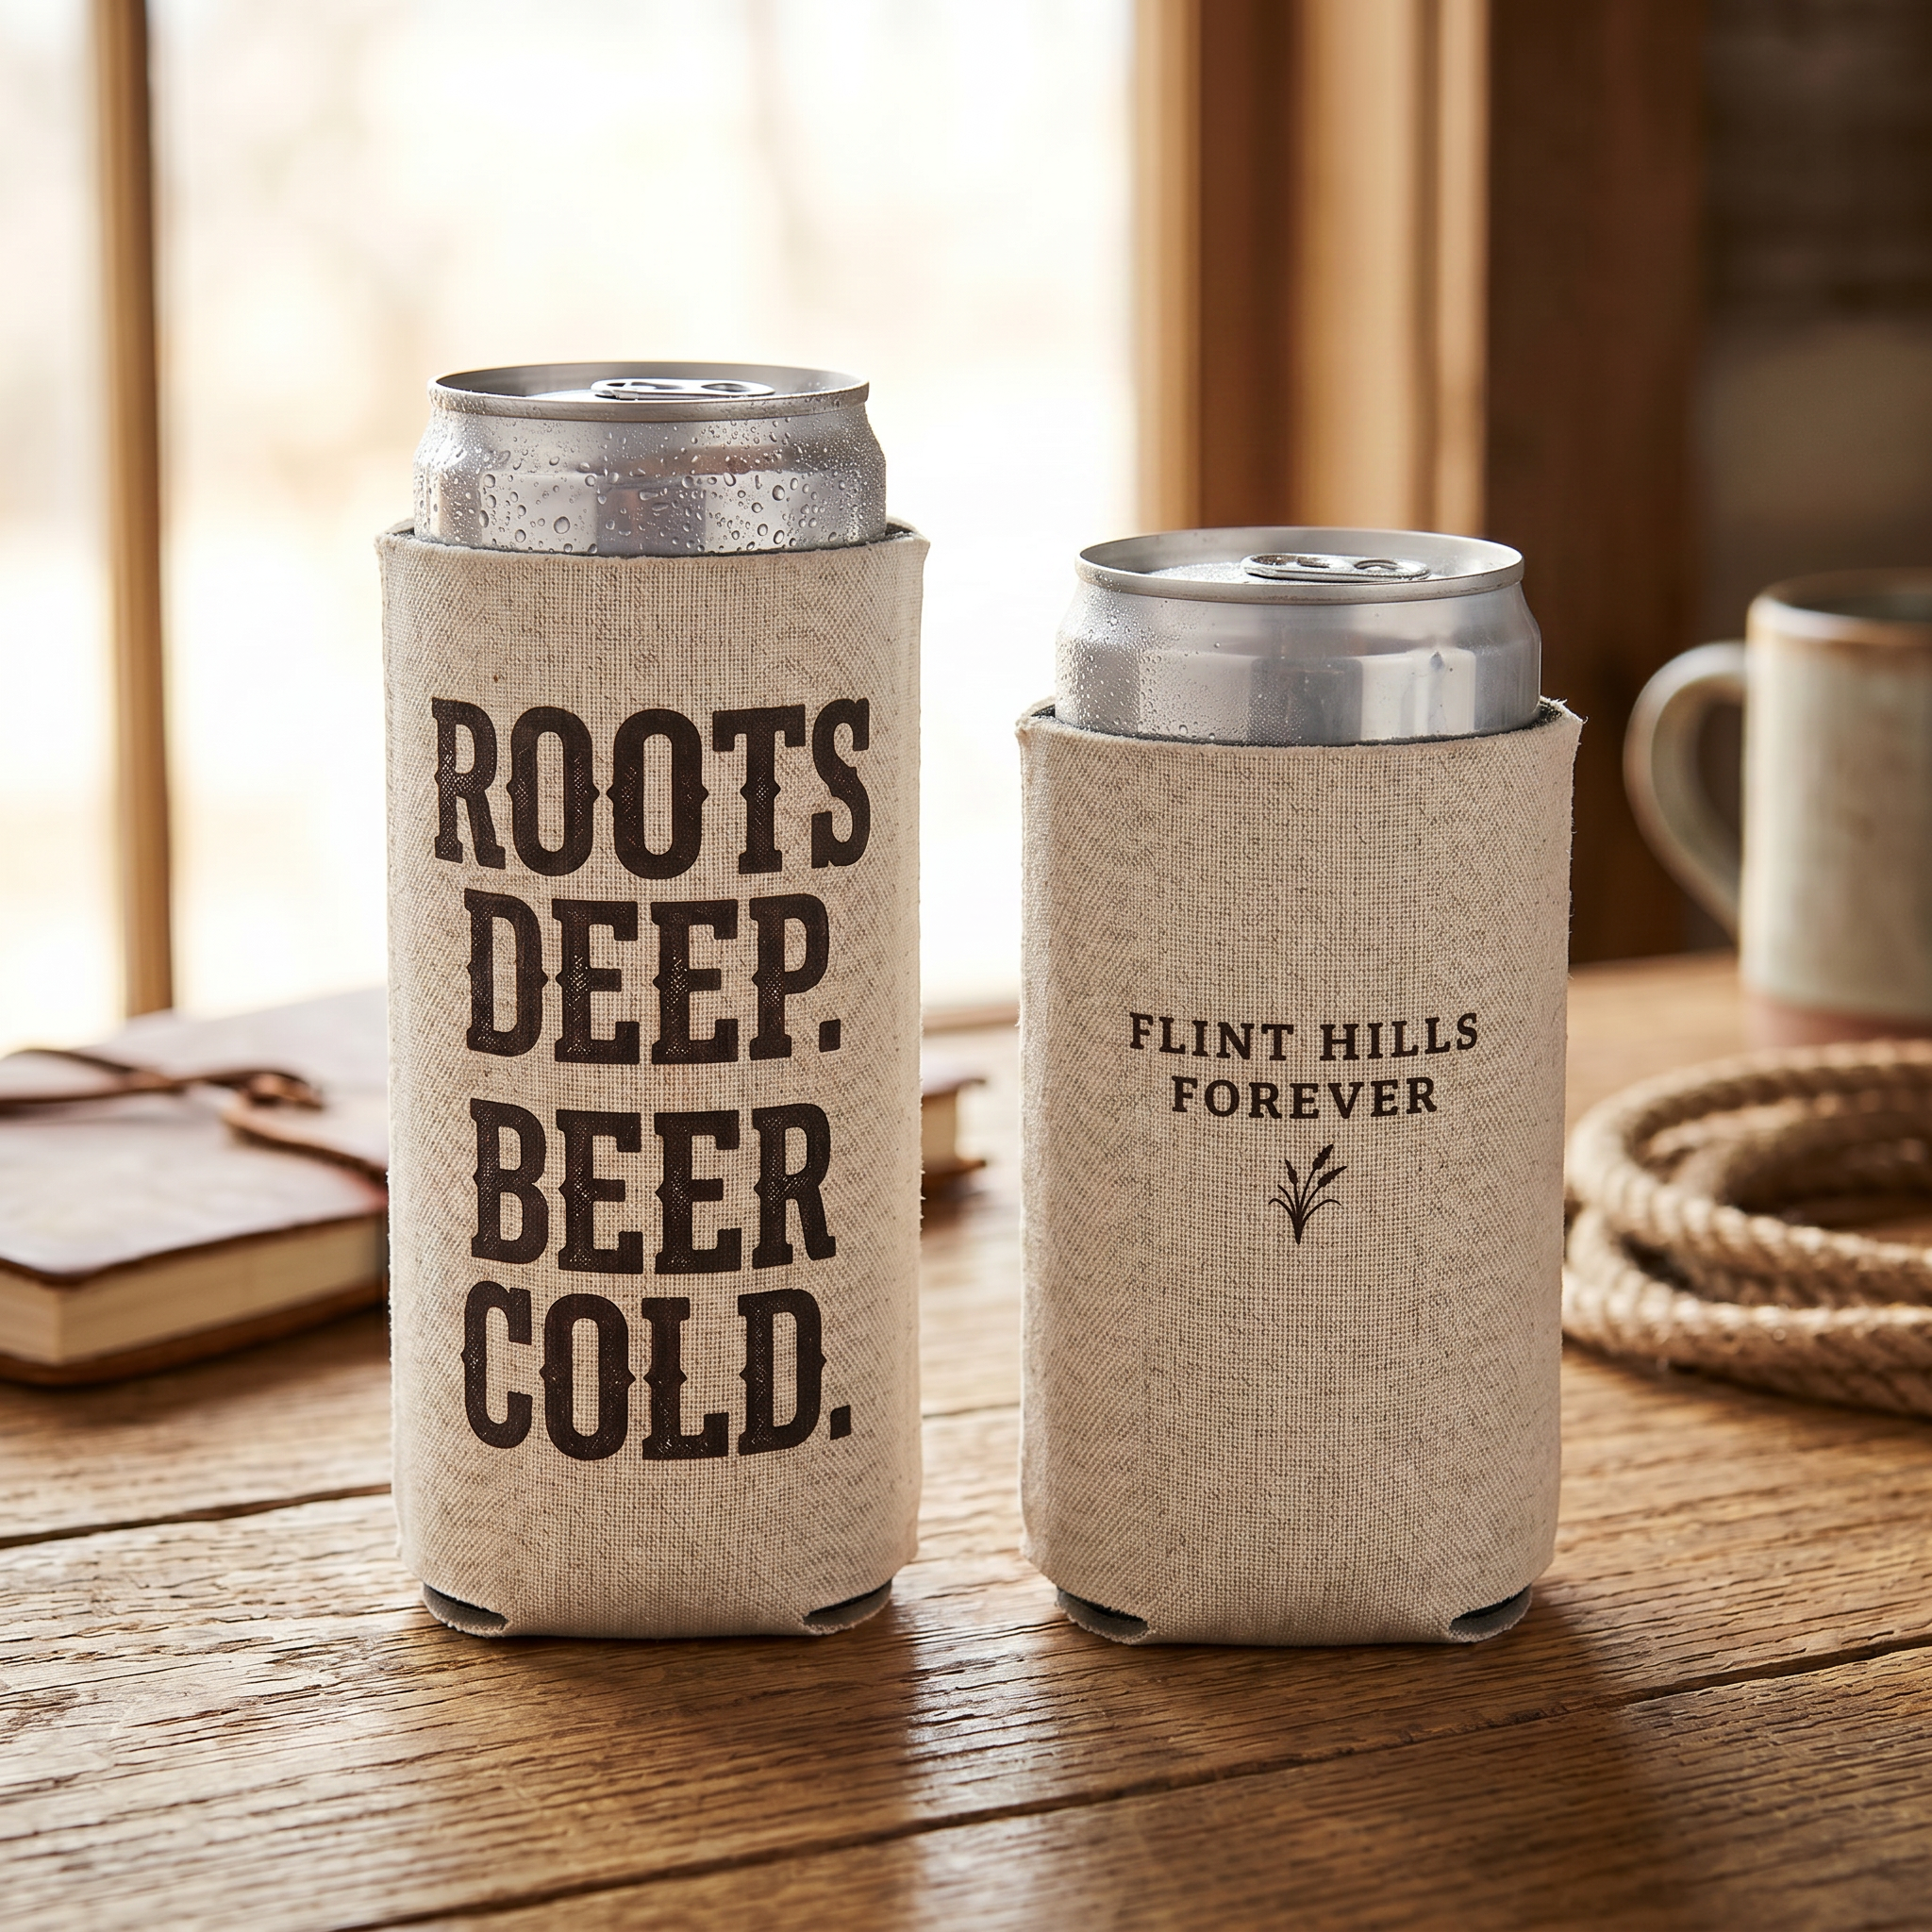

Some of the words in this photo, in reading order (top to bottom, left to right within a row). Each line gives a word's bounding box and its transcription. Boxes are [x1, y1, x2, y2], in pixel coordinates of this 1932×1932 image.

[432, 698, 870, 879] ROOTS
[464, 889, 841, 1065] DEEP.
[1129, 1012, 1293, 1060] FLINT
[1320, 1012, 1477, 1061] HILLS
[1172, 1075, 1437, 1120] FOREVER
[470, 1098, 836, 1274] BEER
[461, 1281, 852, 1462] COLD.
